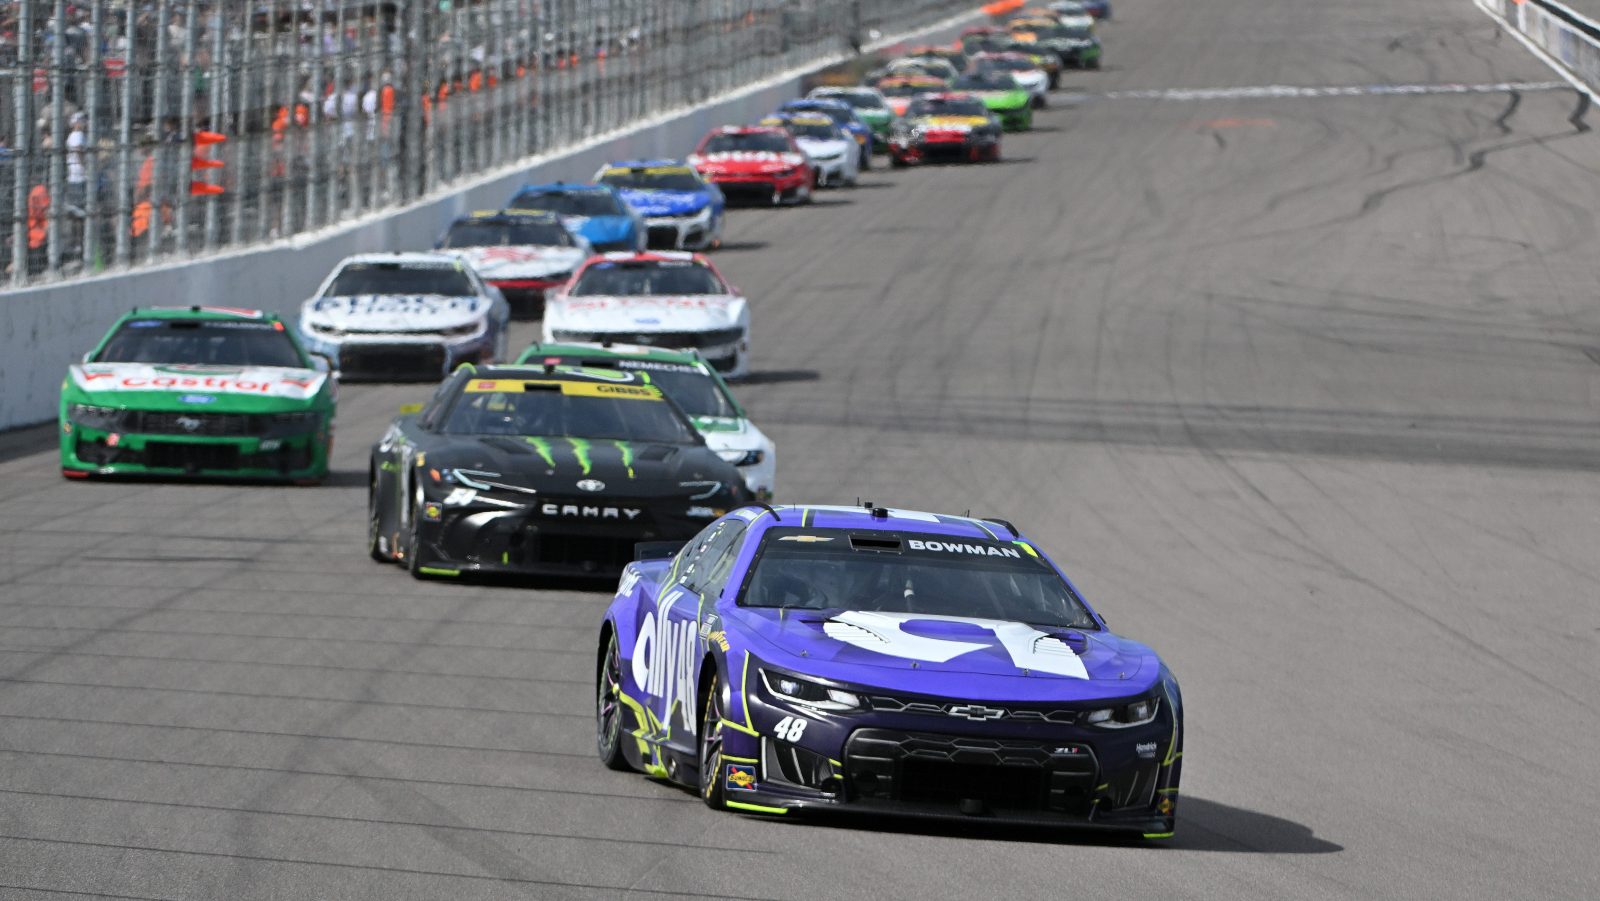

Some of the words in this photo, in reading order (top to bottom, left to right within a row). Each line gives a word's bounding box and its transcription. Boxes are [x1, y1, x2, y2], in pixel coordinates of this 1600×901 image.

[597, 385, 651, 397] GIBBS
[542, 503, 641, 519] CAMRY
[908, 540, 1021, 559] BOWMAN
[774, 716, 807, 742] 48
